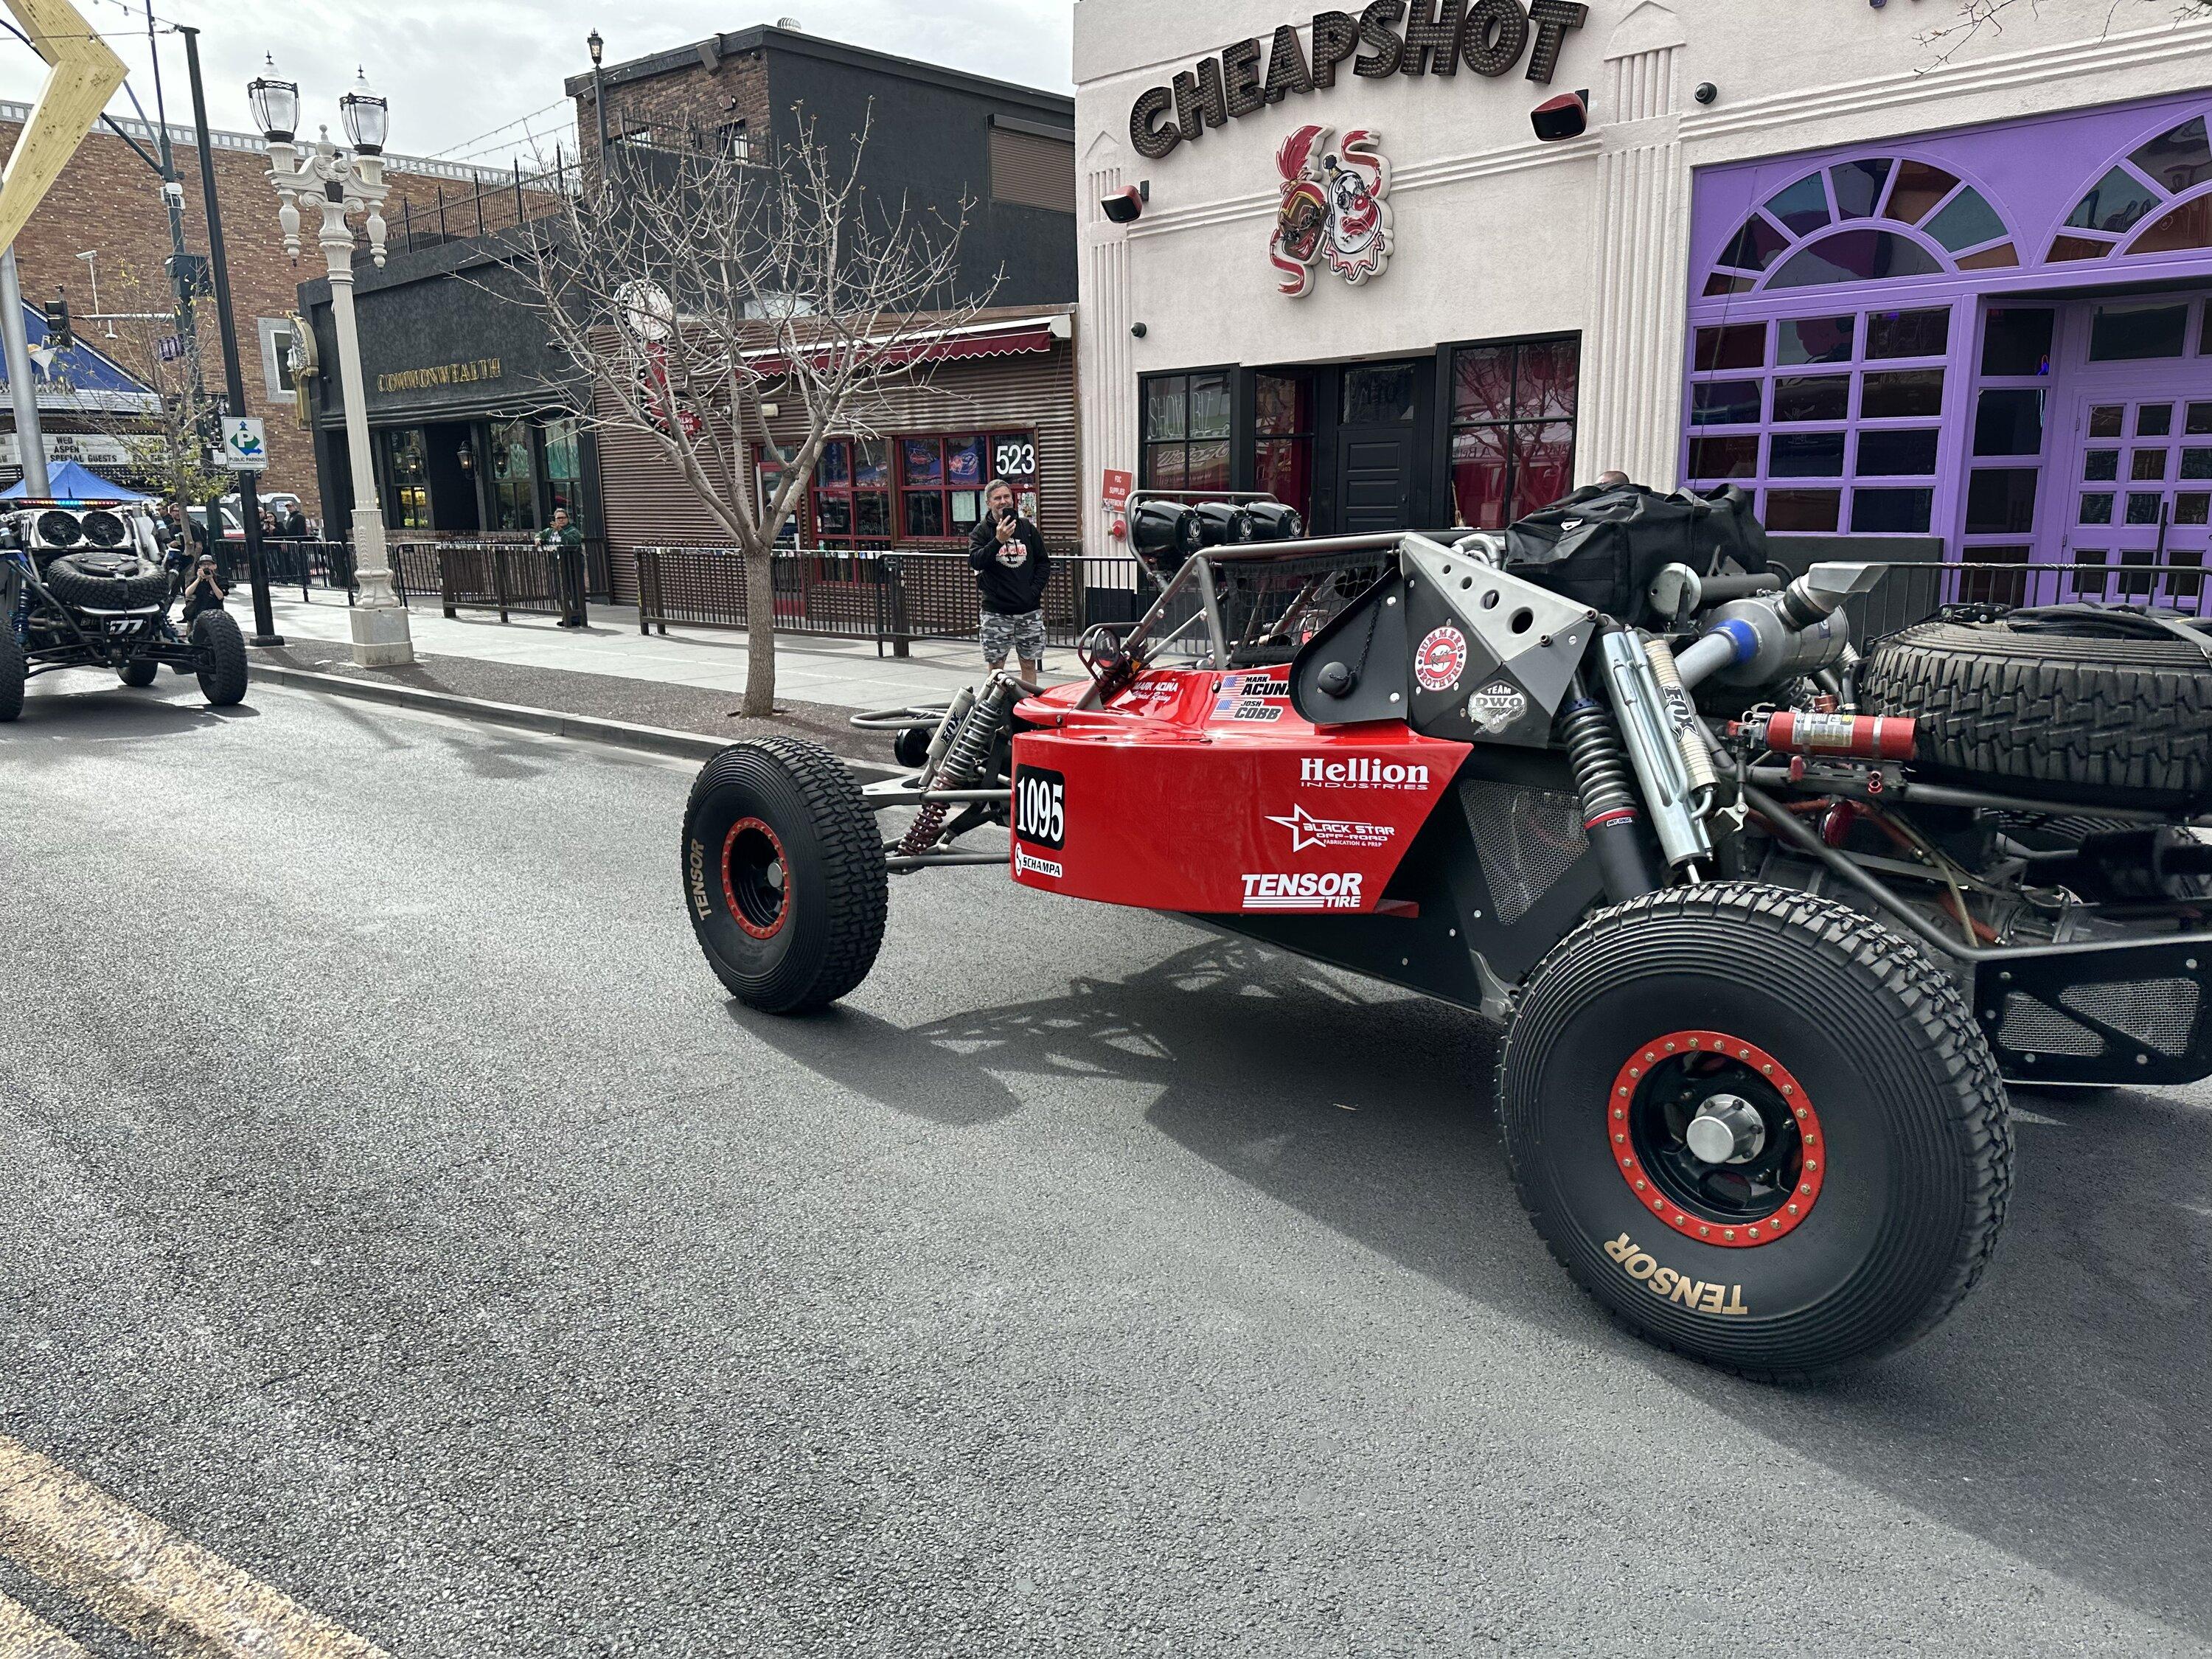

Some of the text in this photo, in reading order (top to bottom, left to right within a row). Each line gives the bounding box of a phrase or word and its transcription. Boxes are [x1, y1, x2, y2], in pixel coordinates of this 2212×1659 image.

[1130, 0, 1589, 159] CHEAPSHOT
[378, 358, 502, 392] COMMONWEALTH
[54, 445, 80, 453] ASPEN
[56, 437, 73, 445] WED
[49, 454, 117, 462] SPECIAL GUESTS
[996, 443, 1035, 475] 523
[1109, 487, 1125, 495] SUPPLIES
[114, 619, 144, 635] 77
[1418, 629, 1465, 658] SUMMERS
[1416, 661, 1463, 688] BROTHERS
[1132, 681, 1155, 691] MARK
[1486, 684, 1512, 695] TEAM
[1150, 691, 1172, 705] Racing
[1234, 706, 1281, 720] COBB
[1661, 686, 1700, 742] FOX
[1300, 757, 1430, 783] Hellion
[1301, 782, 1428, 790] INDUSTRIES
[1017, 776, 1064, 842] 1095
[1303, 822, 1395, 836] BLACK STAR
[1316, 832, 1388, 841] OFF-ROAD
[1023, 856, 1060, 876] SCHAMPA
[689, 838, 713, 921] TENSOR
[1241, 873, 1363, 896] TENSOR
[1326, 896, 1361, 908] TIRE
[1604, 1232, 1748, 1315] TENSOR
